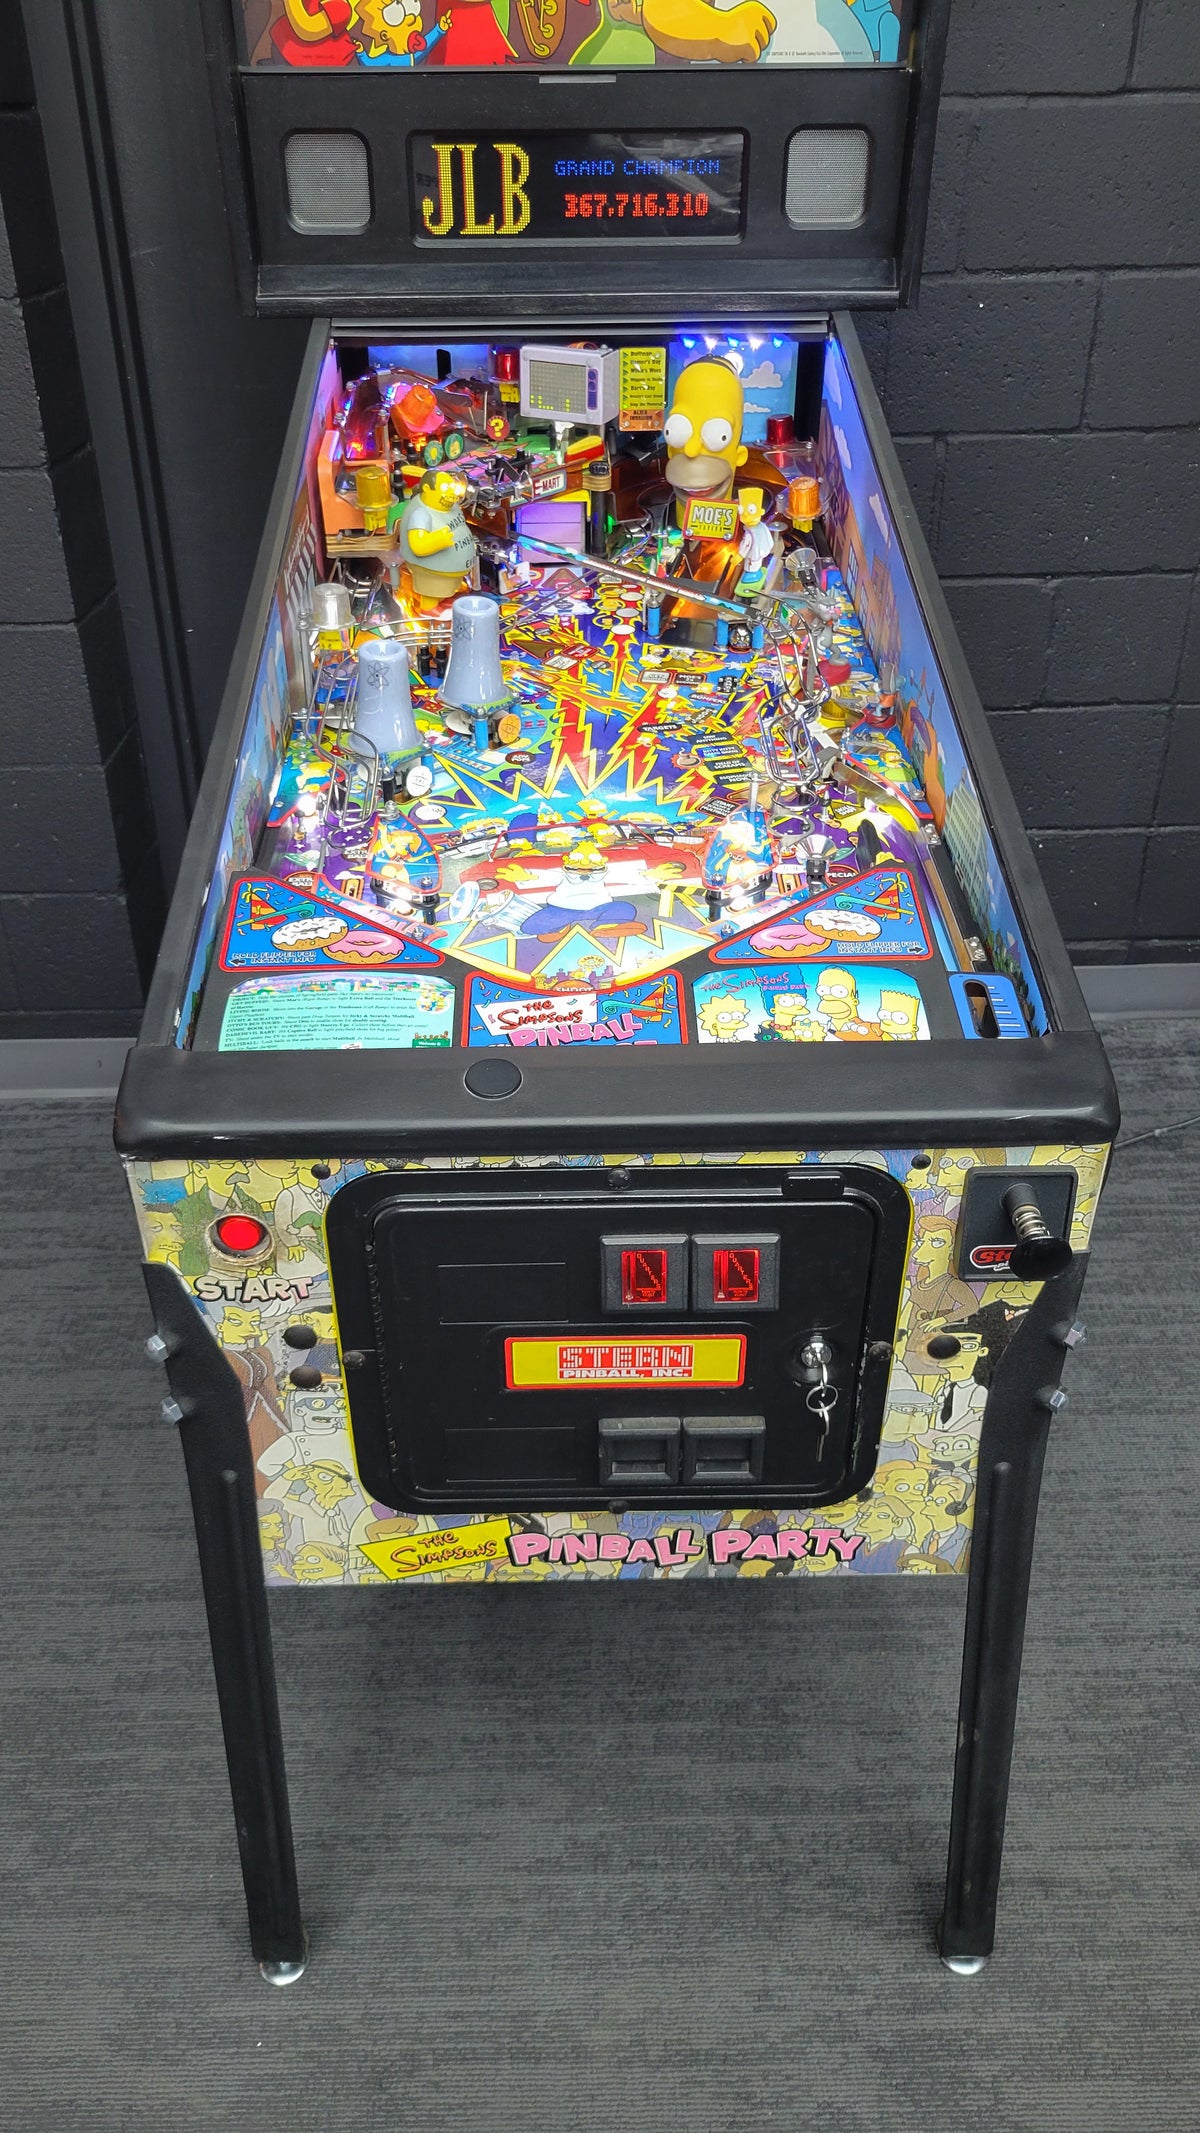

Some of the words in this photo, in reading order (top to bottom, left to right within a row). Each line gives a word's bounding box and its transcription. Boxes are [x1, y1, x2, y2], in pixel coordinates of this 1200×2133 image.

[554, 159, 615, 176] GRAND
[623, 159, 721, 175] CHAMPION
[422, 143, 531, 235] JLB
[564, 193, 709, 218] 367,716,310
[692, 506, 733, 526] MOE'S
[700, 983, 722, 992] THE
[722, 972, 790, 993] SIMPSONS
[522, 999, 554, 1010] THE
[497, 1008, 583, 1030] SIMPSONS
[509, 1013, 643, 1047] PINBALL
[194, 1275, 313, 1302] START
[562, 1346, 690, 1368] STERN
[563, 1369, 644, 1379] PINBALL,
[652, 1369, 689, 1378] INC.
[418, 1531, 459, 1548] THE
[508, 1530, 704, 1568] PINBALL
[710, 1528, 866, 1565] PARTY
[390, 1539, 498, 1573] SIMPSONS
